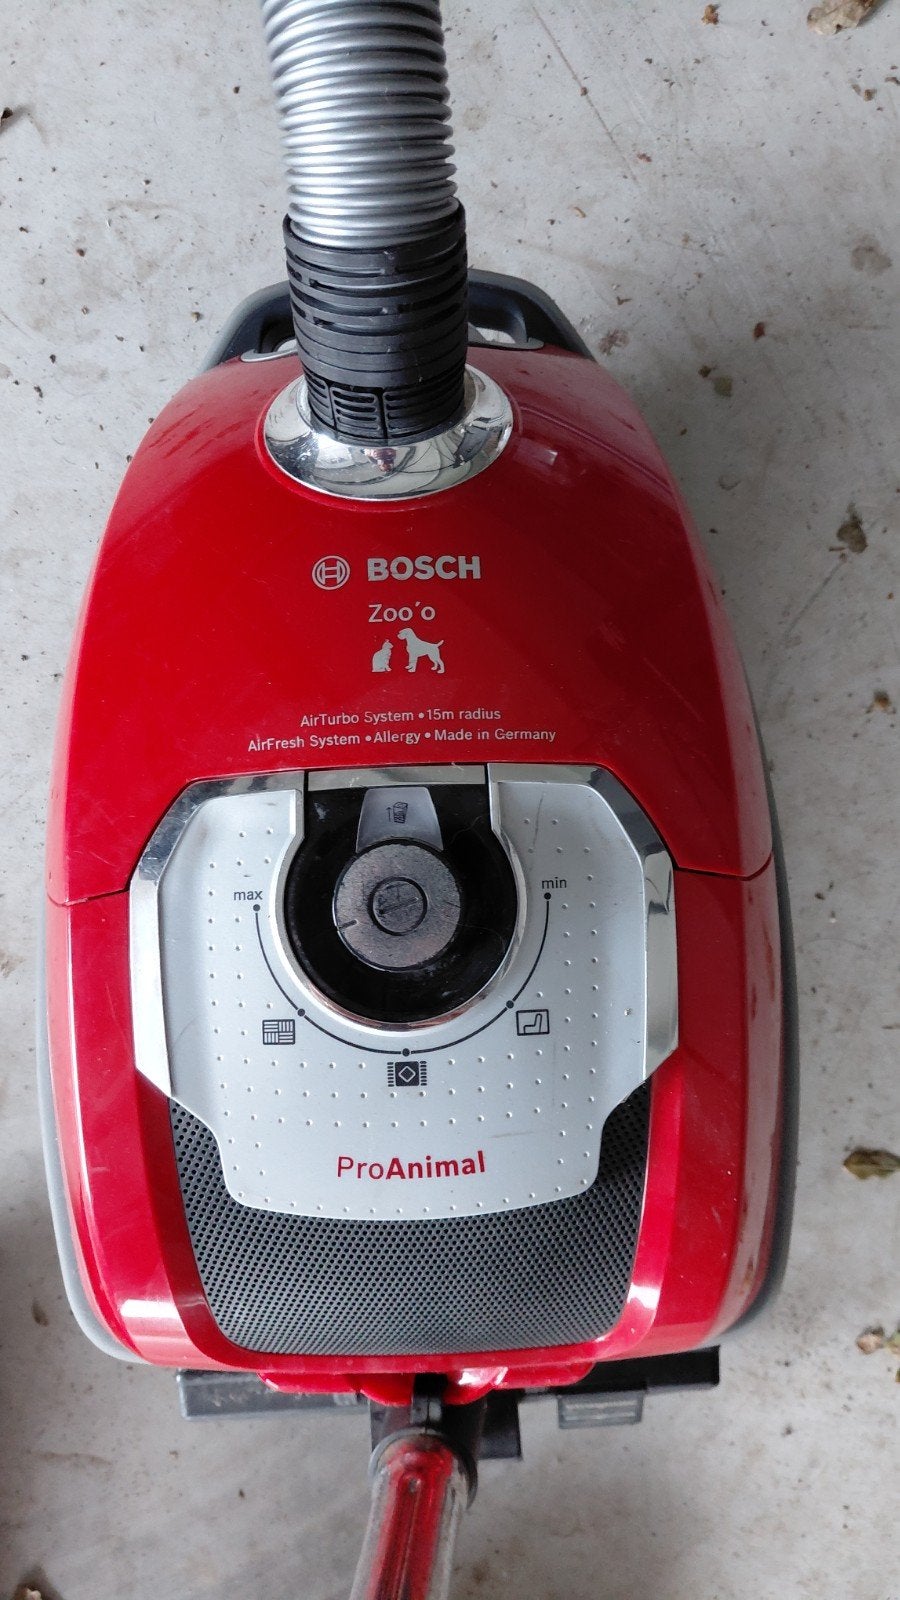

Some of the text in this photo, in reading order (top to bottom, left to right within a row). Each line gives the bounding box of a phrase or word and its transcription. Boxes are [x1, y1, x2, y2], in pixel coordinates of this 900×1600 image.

[367, 555, 481, 582] BOSCH
[300, 712, 360, 728] AirTurbo
[364, 707, 414, 726] System
[459, 707, 502, 721] radius
[248, 727, 557, 752] AirFresh System Allergy Made in Germany
[541, 876, 567, 890] min
[233, 890, 263, 901] max
[337, 1150, 486, 1180] ProAnimal
